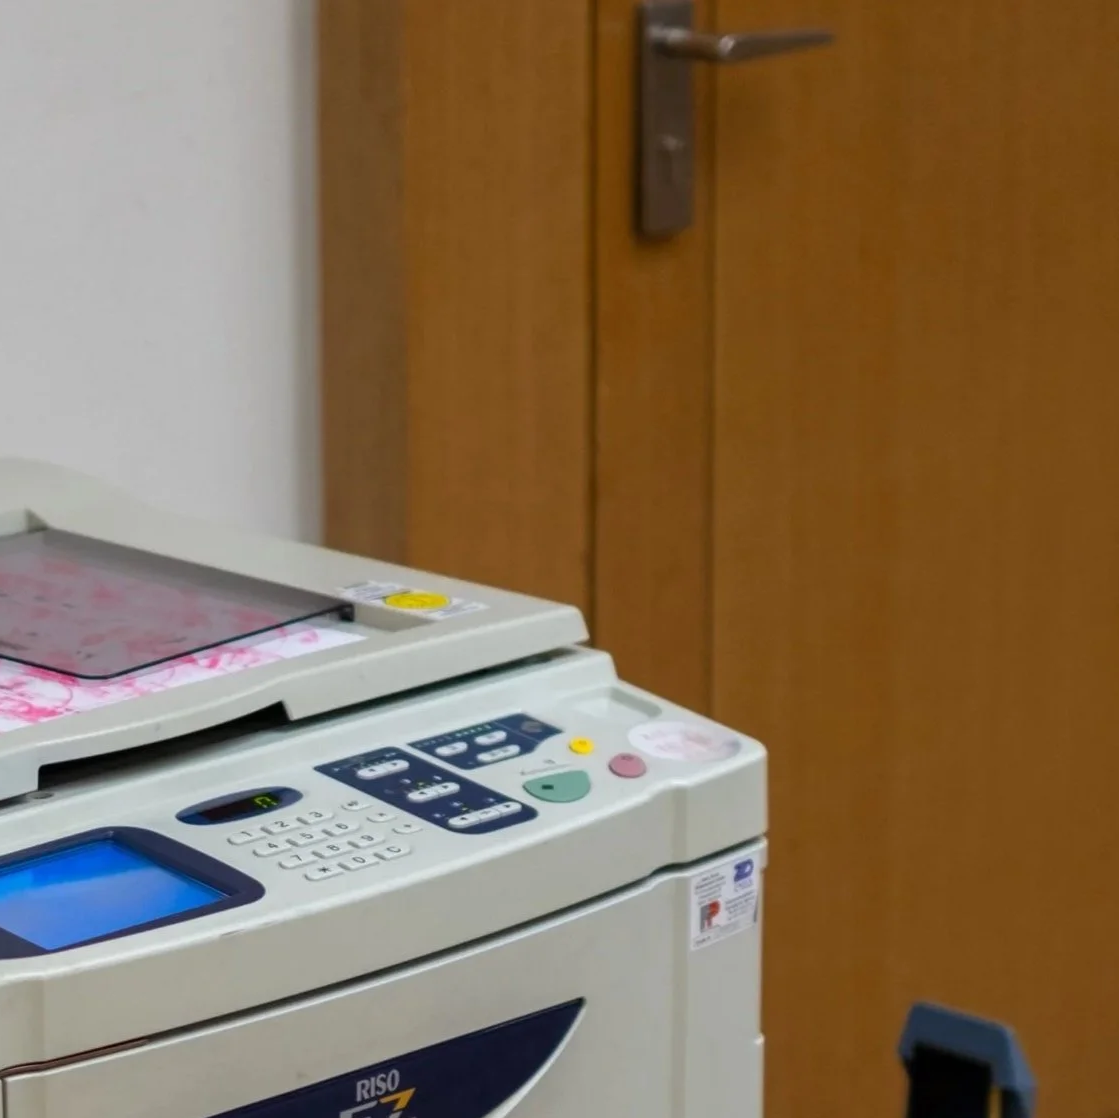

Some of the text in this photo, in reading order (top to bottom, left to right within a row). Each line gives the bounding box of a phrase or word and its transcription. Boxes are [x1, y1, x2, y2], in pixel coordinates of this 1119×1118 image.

[274, 820, 289, 828] 2
[309, 811, 323, 819] 3
[267, 842, 279, 850] 4
[299, 832, 314, 840] 5
[290, 834, 374, 862] 7 8 9
[352, 846, 402, 864] 0 C
[356, 1069, 400, 1102] RISO
